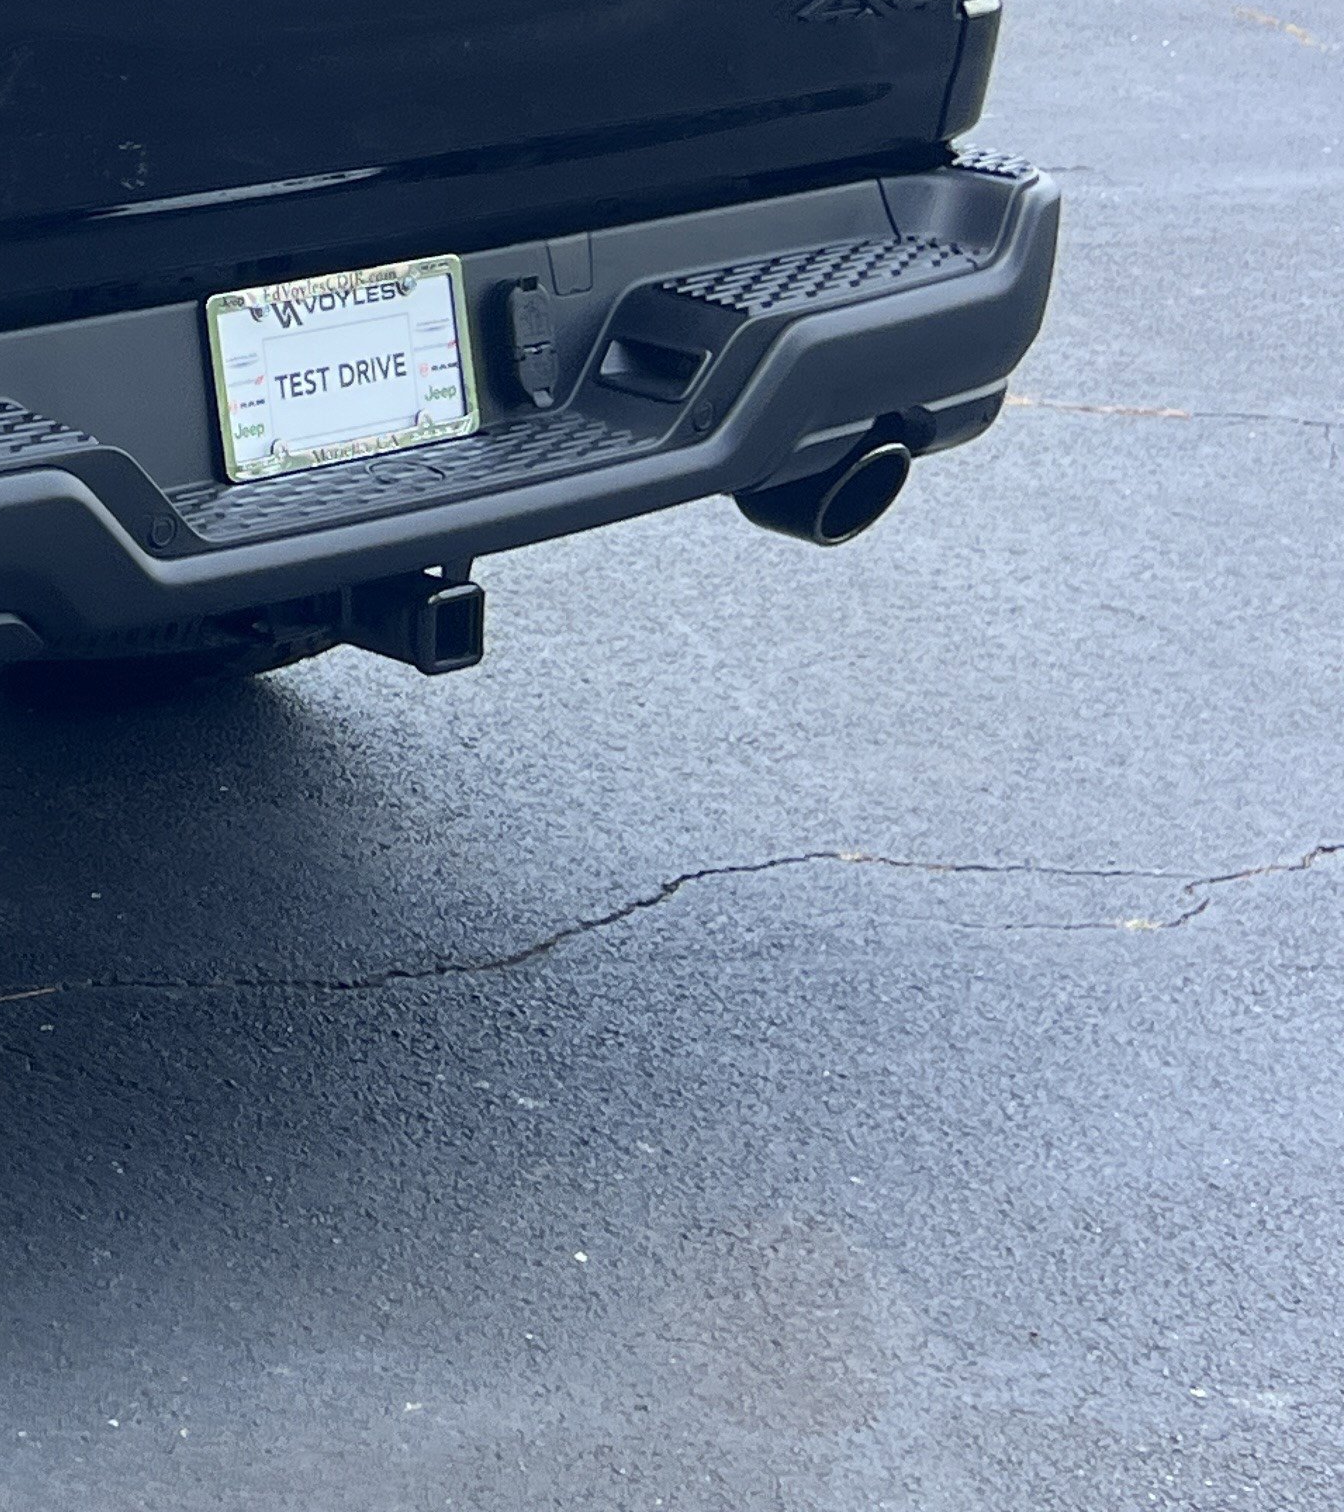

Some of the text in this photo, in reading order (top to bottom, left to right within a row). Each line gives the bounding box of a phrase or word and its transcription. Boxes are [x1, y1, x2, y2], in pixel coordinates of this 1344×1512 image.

[299, 281, 396, 315] VOYLES
[274, 352, 408, 400] TEST DRIVE
[424, 384, 457, 402] Jeep
[234, 422, 265, 439] Jeep
